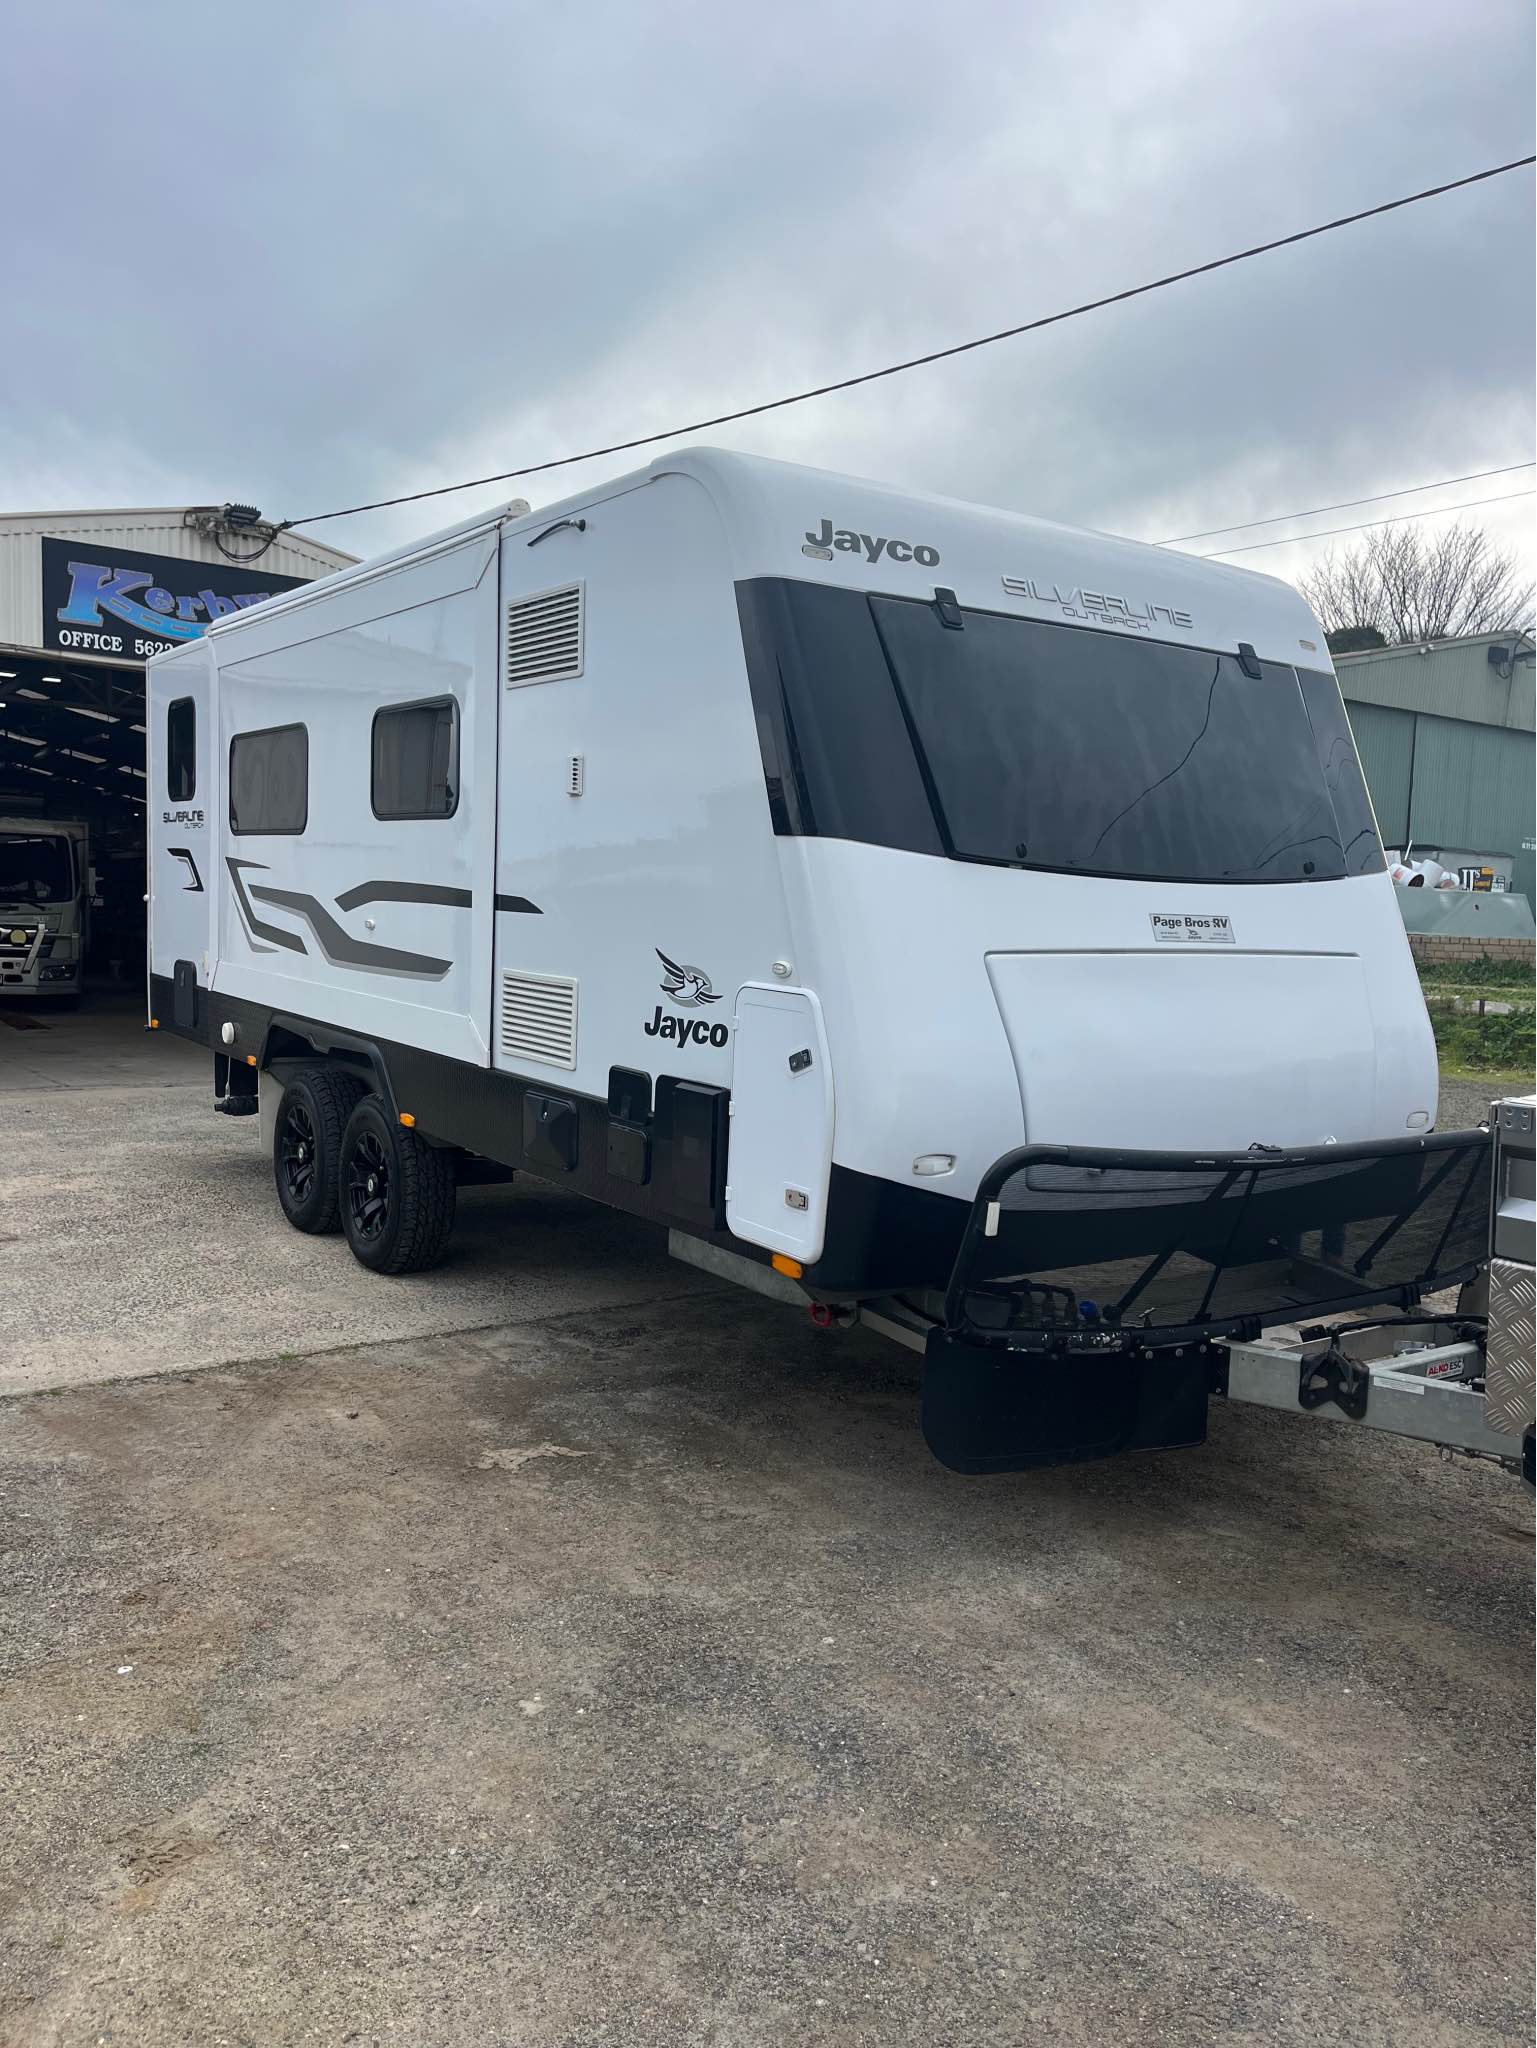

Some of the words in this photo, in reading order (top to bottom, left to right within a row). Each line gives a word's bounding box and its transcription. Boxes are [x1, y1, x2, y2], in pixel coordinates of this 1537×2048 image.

[805, 519, 940, 567] Jayco
[57, 561, 283, 641] Kerb
[1001, 575, 1193, 629] SILVERLINE
[1062, 606, 1151, 632] OUTBACK
[58, 630, 123, 652] OFFICE
[1153, 916, 1182, 929] Page
[1184, 917, 1210, 928] Bros
[1213, 918, 1228, 928] RV
[644, 1006, 728, 1049] Jayco
[1450, 1360, 1463, 1370] ESC
